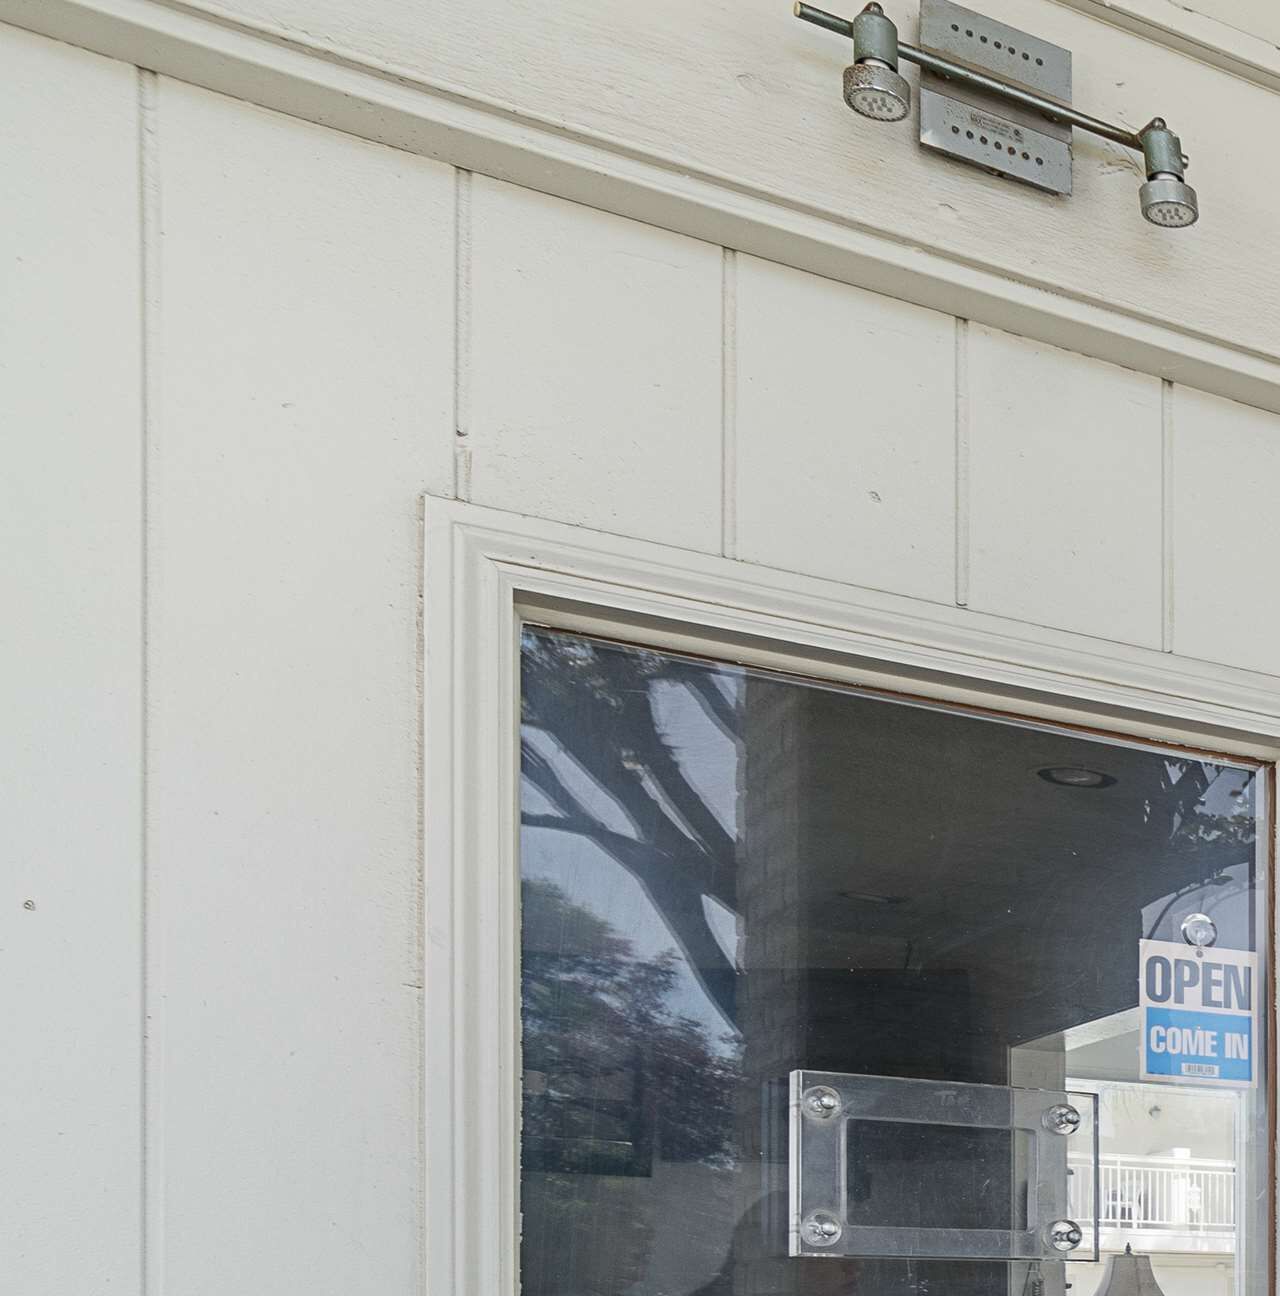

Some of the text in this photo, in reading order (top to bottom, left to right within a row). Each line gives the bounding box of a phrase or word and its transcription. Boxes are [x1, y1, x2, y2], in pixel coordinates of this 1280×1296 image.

[1146, 956, 1251, 1010] OPEN
[1151, 1025, 1248, 1060] COME IN
